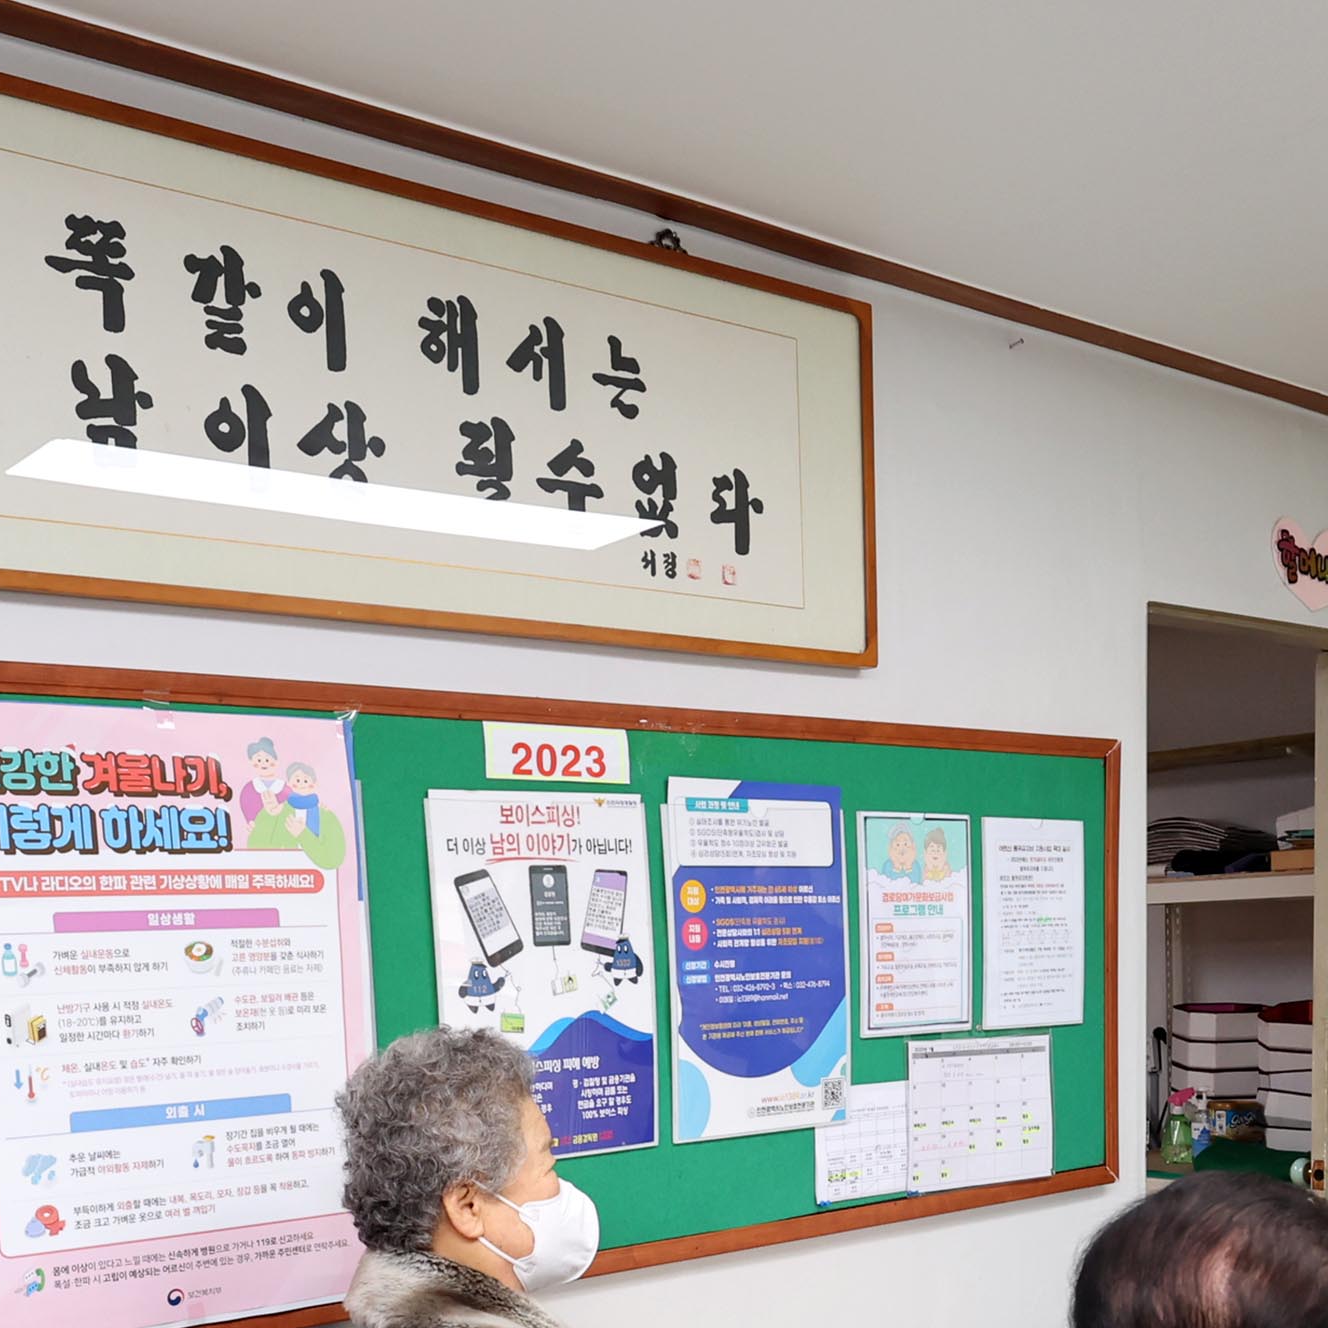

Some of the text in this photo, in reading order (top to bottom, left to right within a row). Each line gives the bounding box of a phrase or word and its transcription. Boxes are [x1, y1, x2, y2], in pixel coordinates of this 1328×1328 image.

[417, 295, 648, 419] 해서는
[511, 742, 607, 778] 2023
[80, 748, 233, 801] 겨울나기,
[499, 803, 581, 828] 보이스피싱!
[100, 802, 233, 855] 하세요!
[446, 832, 633, 856] 더 이상 남의 이야기가 아닙니다!
[40, 875, 96, 891] 라디오의
[98, 874, 127, 890] 한파
[129, 874, 156, 890] 관련
[159, 873, 224, 890] 기상상황에
[223, 873, 249, 889] 매일
[251, 873, 314, 889] 주목하세요!
[147, 911, 195, 926] 일상생활
[927, 904, 944, 916] 안내
[52, 947, 130, 961] 가벼운 실내운동으로
[54, 961, 168, 975] 신체활동이 부족하지 않게 하기
[56, 998, 172, 1014] 난방기구 사용 시 적정 실내온도
[58, 1027, 154, 1043] 일정한 시간마다 환기하기
[83, 1060, 116, 1072] 실내온도
[119, 1059, 127, 1069] 및
[152, 1056, 168, 1067] 자주
[170, 1054, 201, 1066] 확인하기
[165, 1103, 205, 1119] 외출 시
[69, 1149, 120, 1163] 추운 날씨에는
[70, 1158, 164, 1178] 가급적 야외활동 자제하기
[52, 1264, 70, 1277] 몸에
[71, 1261, 96, 1275] 이상이
[97, 1257, 122, 1270] 있다고
[124, 1255, 140, 1267] 느낄
[141, 1251, 165, 1264] 때에는
[167, 1246, 199, 1261] 신속하게
[199, 1242, 230, 1257] 병원으로
[231, 1239, 254, 1251] 가거나
[256, 1236, 277, 1247] 119로
